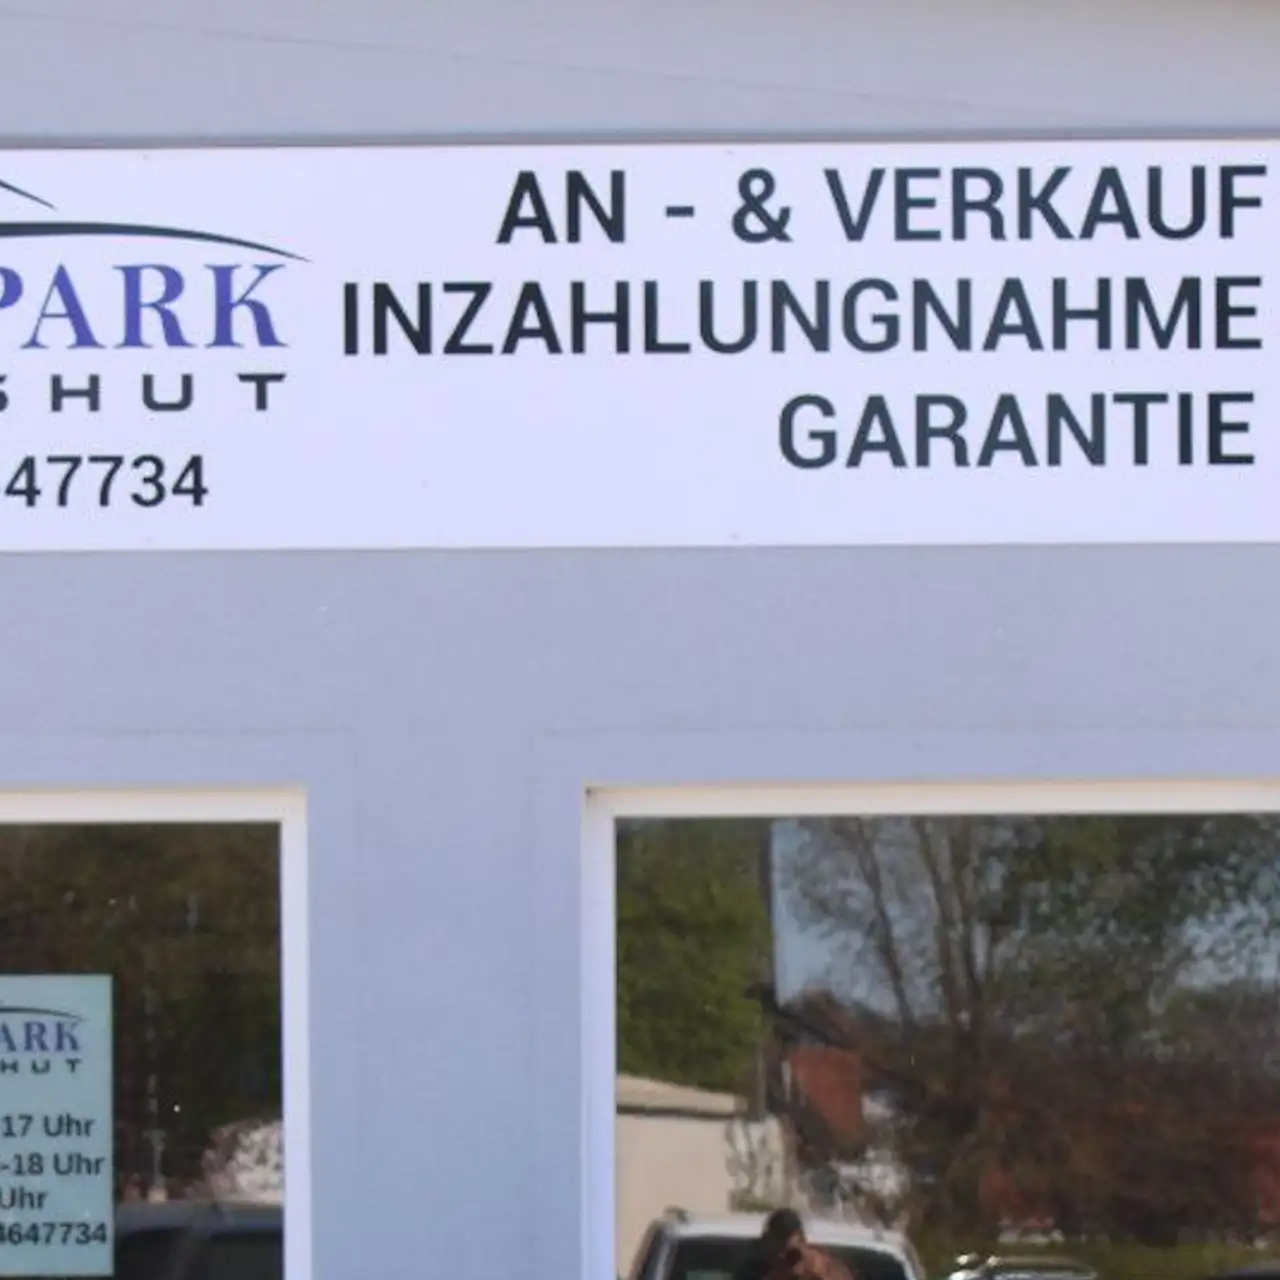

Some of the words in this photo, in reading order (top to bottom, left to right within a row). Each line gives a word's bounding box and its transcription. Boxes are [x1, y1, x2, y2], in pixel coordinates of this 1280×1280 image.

[495, 168, 626, 245] AN
[665, 205, 695, 218] -
[731, 168, 792, 244] &
[823, 164, 1268, 242] VERKAUF
[342, 275, 1263, 356] INZAHLUNGNAHME
[778, 391, 1255, 470] GARANTIE
[42, 1113, 96, 1138] Uhr
[52, 1151, 107, 1176] Uhr
